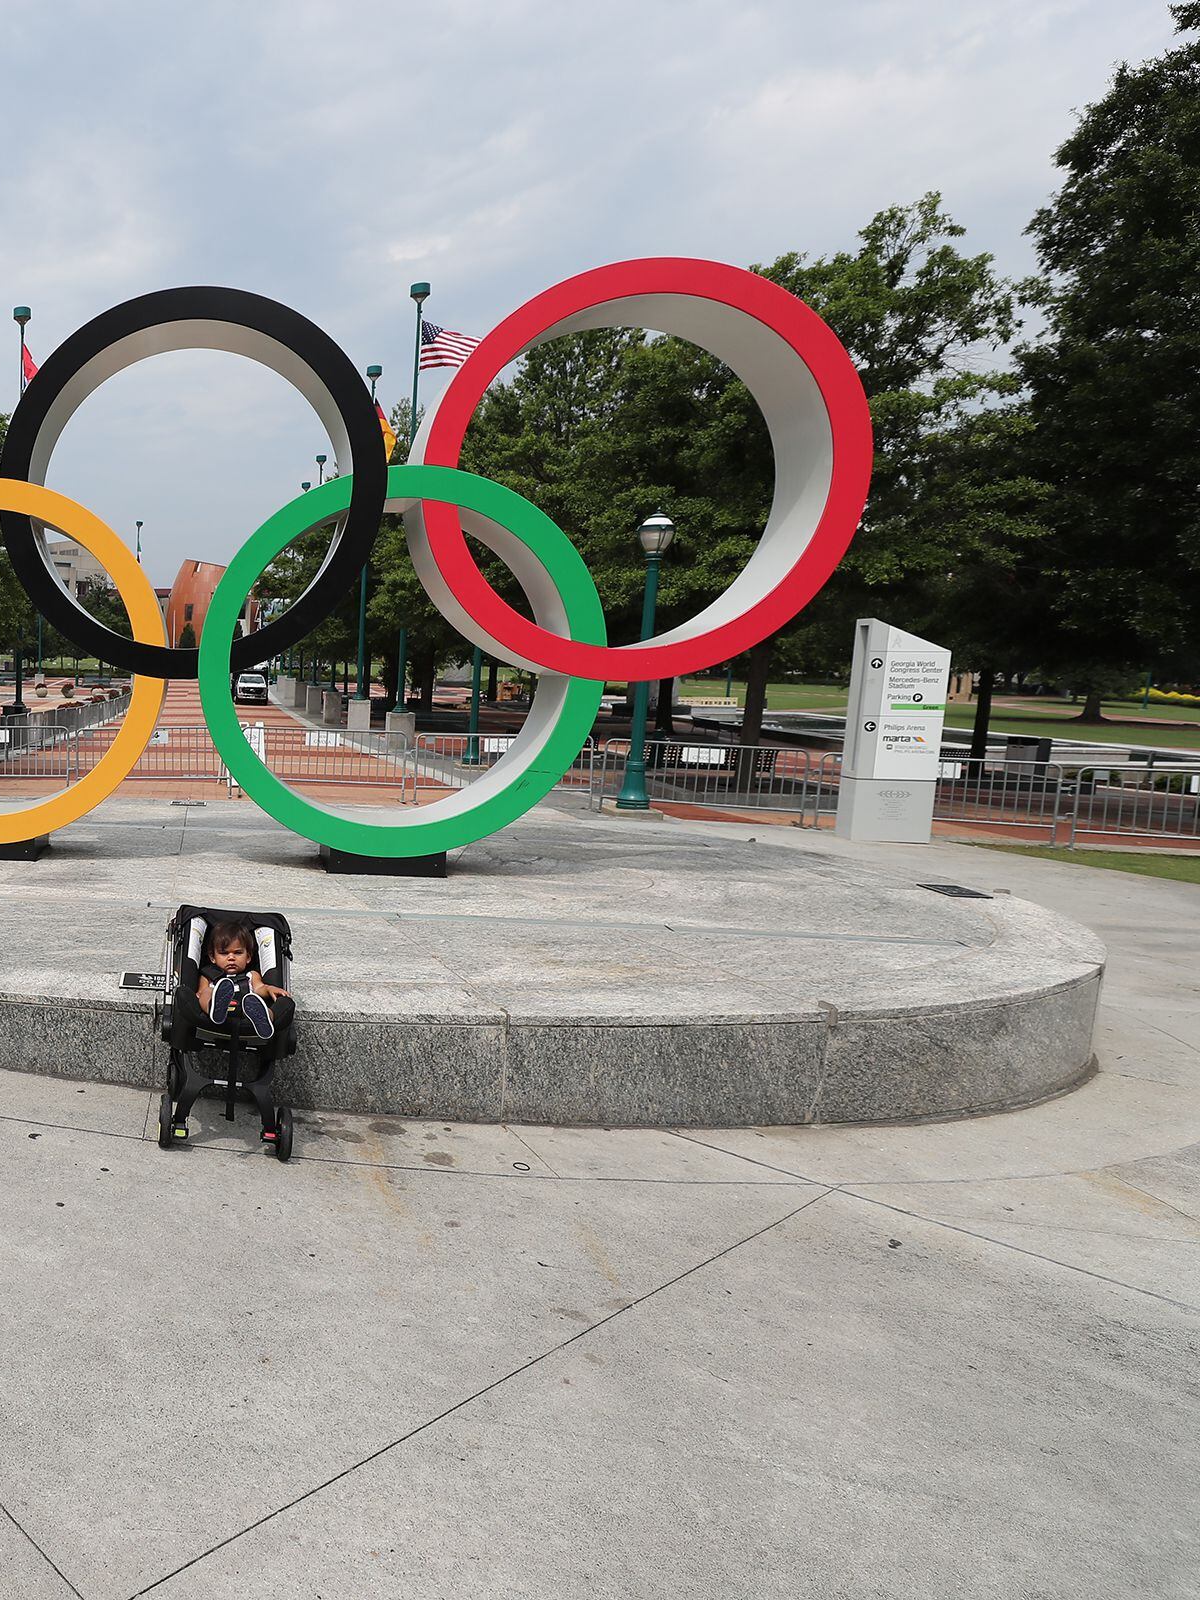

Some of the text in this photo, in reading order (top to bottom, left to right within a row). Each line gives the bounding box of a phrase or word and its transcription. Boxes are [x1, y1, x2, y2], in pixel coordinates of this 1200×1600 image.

[887, 693, 911, 701] Parking
[884, 723, 906, 731] Philips
[883, 735, 911, 743] marta
